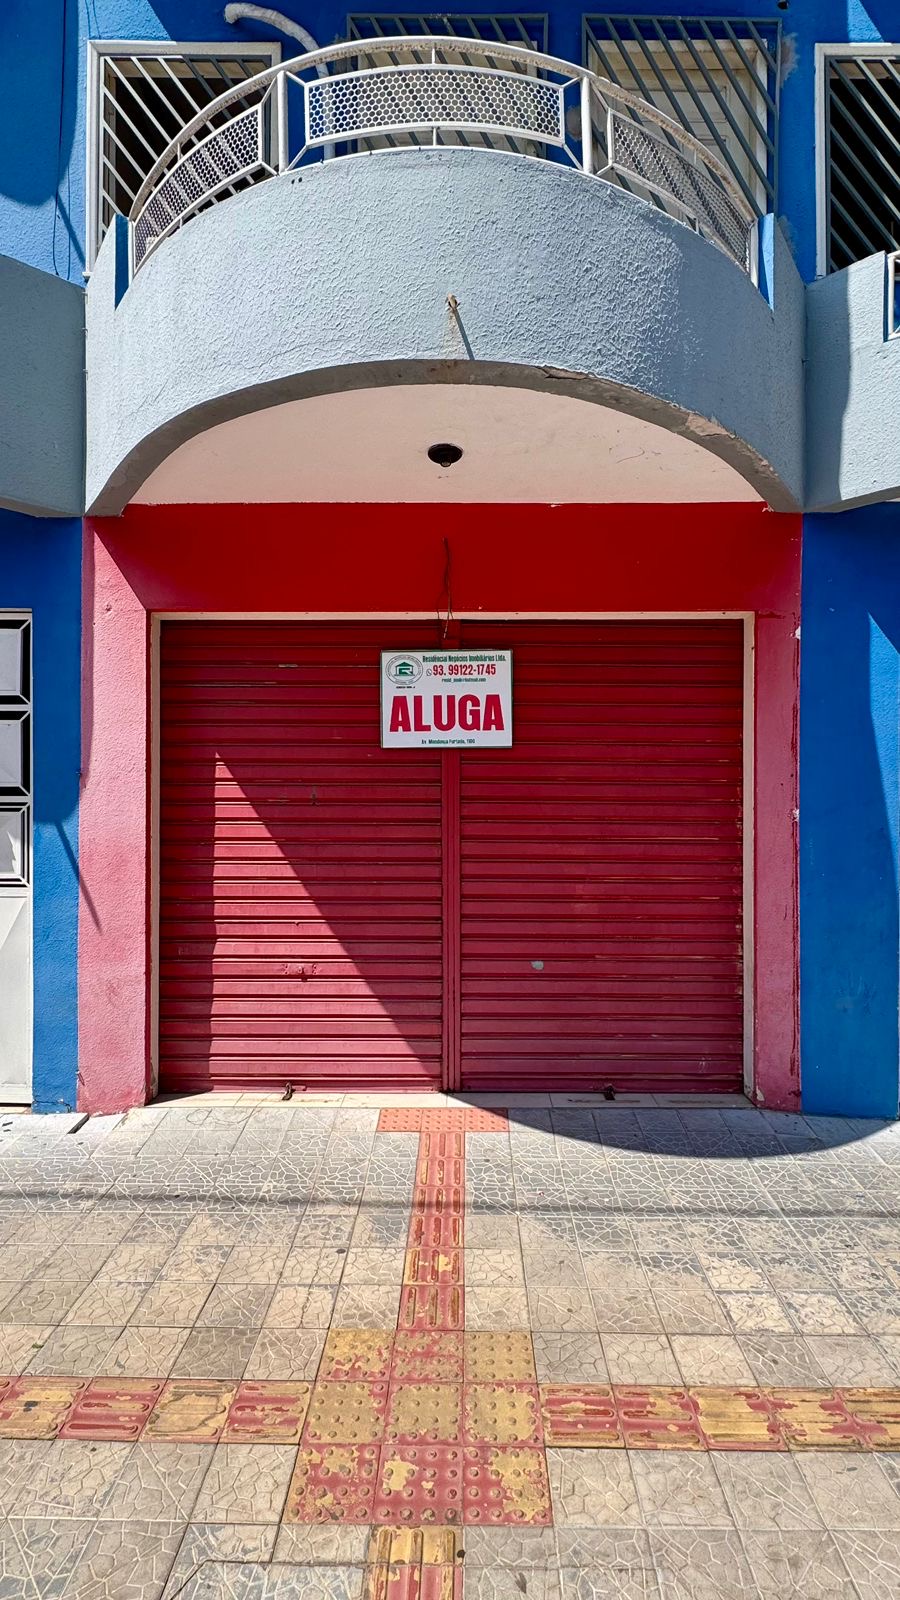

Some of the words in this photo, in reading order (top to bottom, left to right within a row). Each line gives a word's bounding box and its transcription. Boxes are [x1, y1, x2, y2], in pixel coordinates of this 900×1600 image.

[433, 664, 446, 676] 93.
[448, 664, 496, 676] 99122-1745
[389, 694, 505, 732] ALUGA
